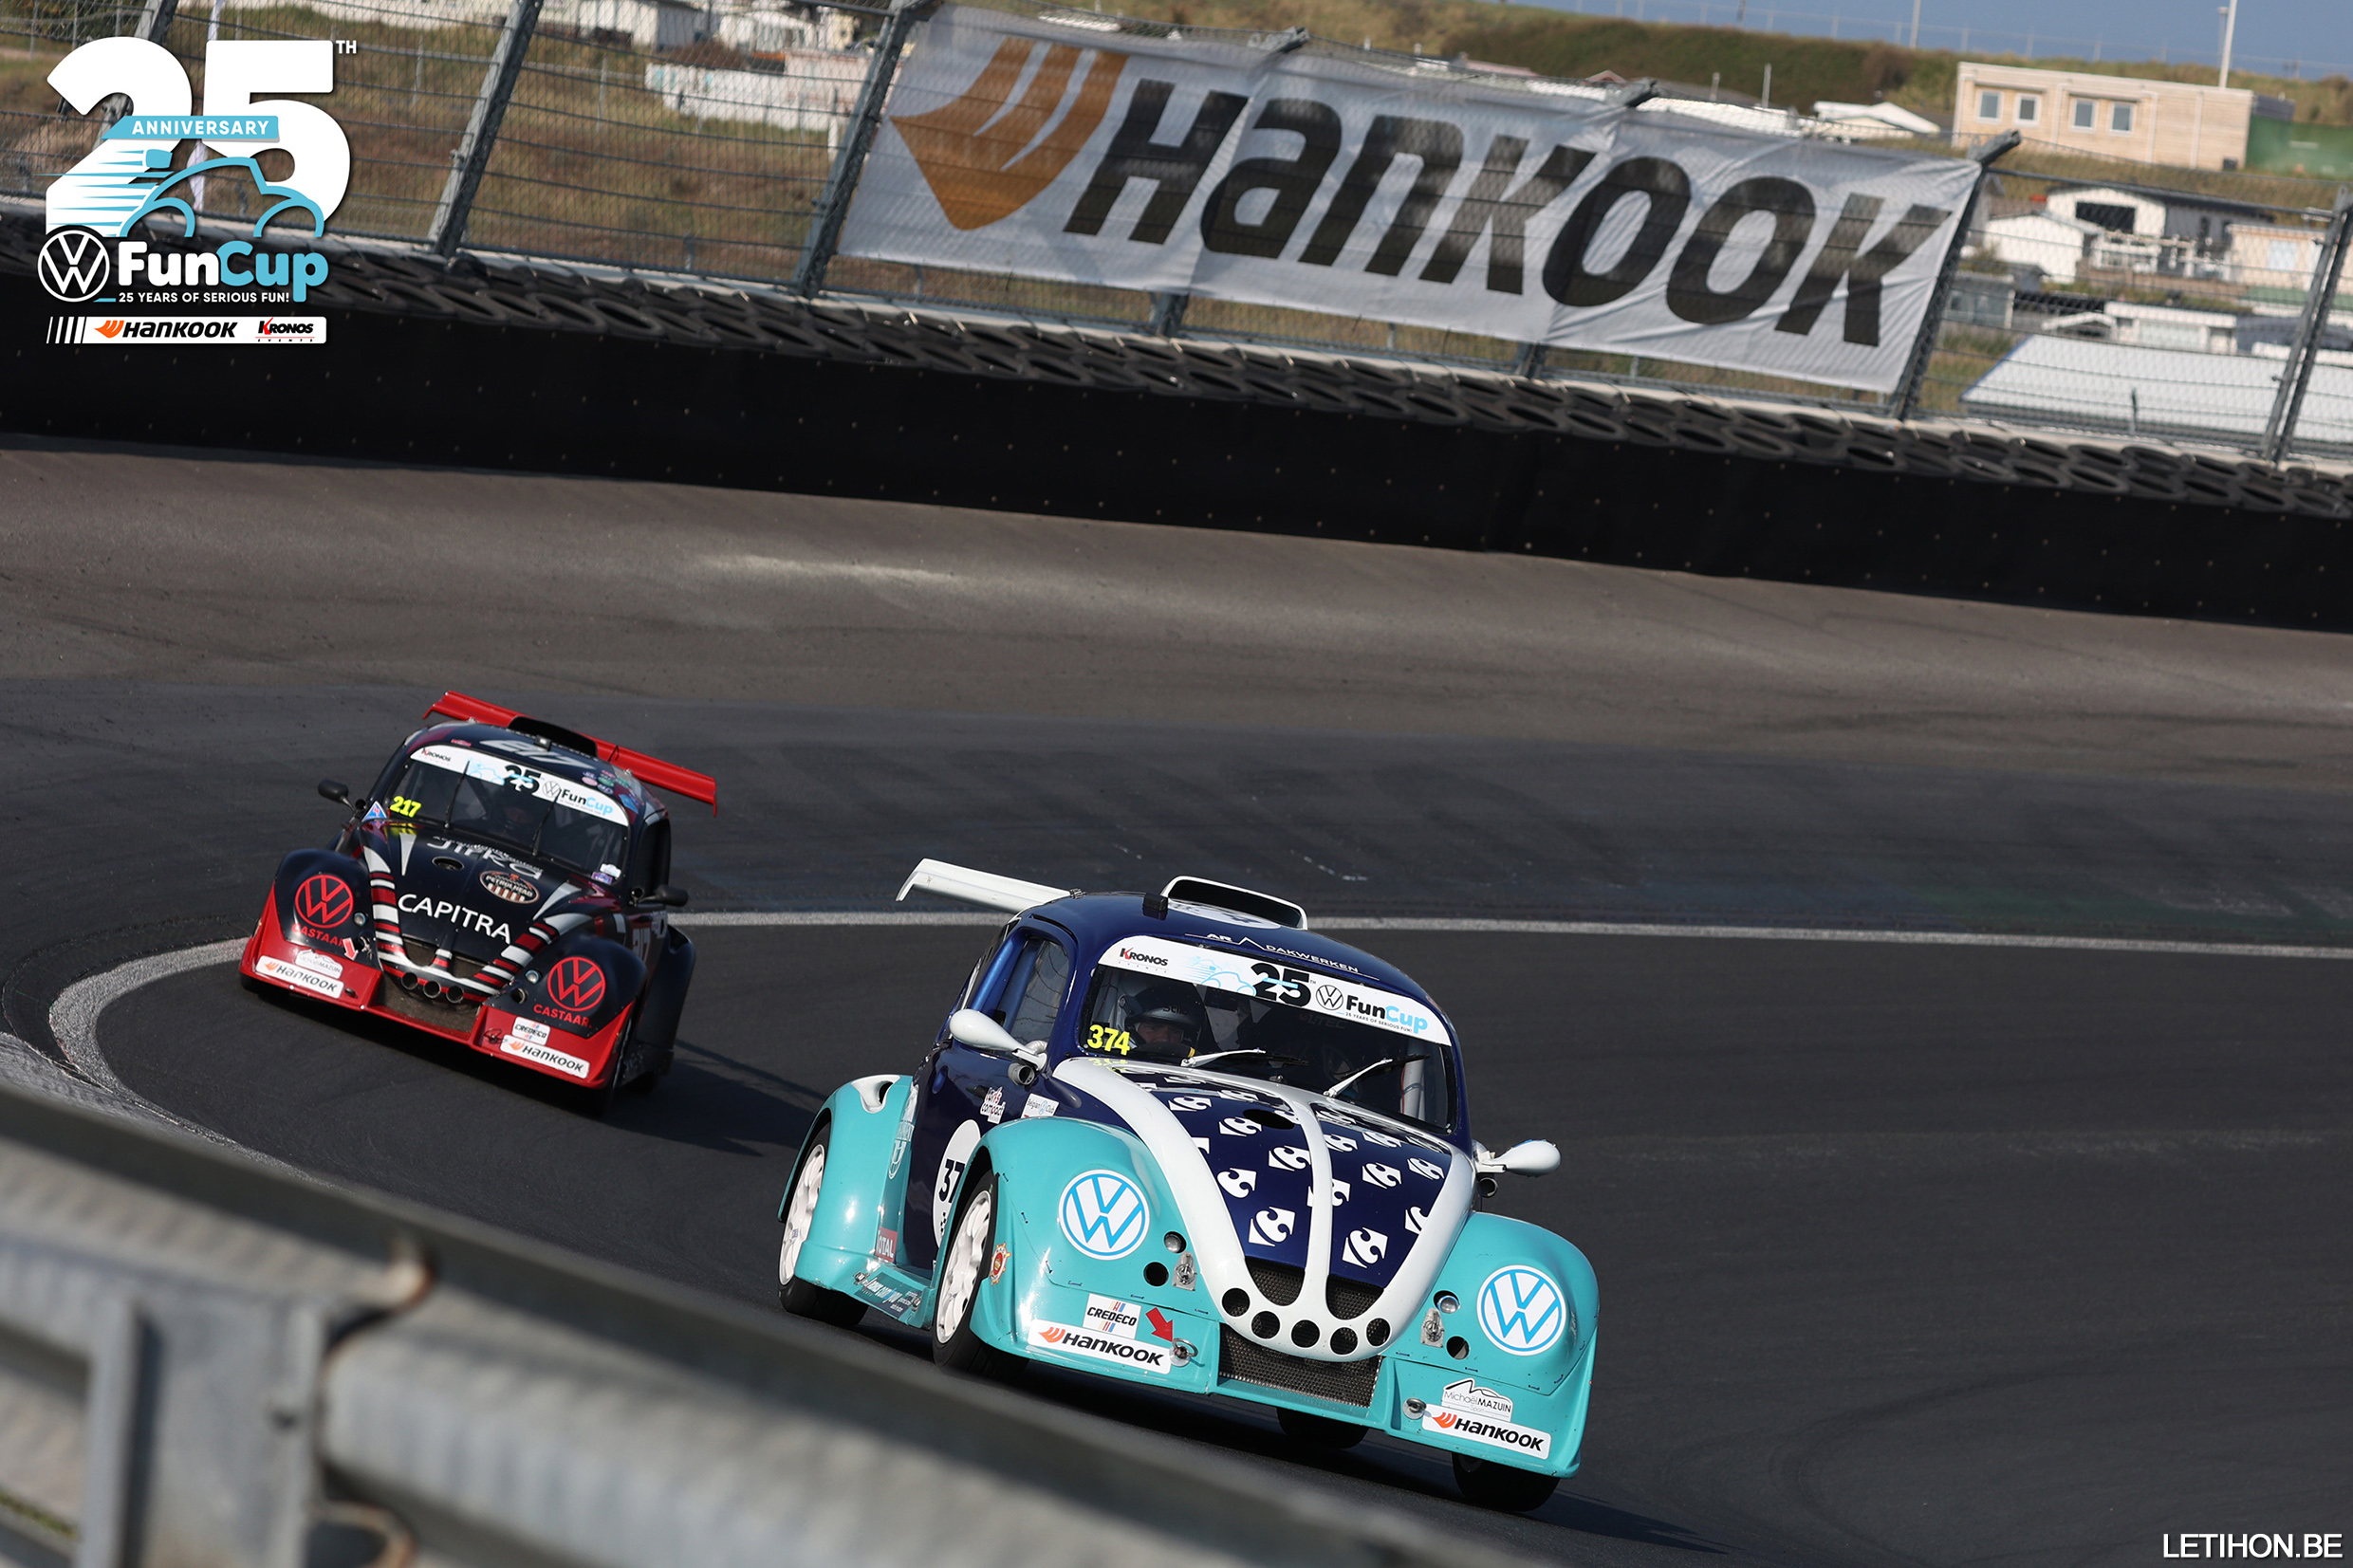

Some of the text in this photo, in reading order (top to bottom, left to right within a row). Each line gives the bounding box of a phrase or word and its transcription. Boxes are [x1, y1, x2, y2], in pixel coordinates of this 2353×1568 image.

[390, 796, 422, 818] 217
[398, 894, 511, 944] CAPITRA
[1266, 945, 1359, 973] DAKWERKEN
[1119, 947, 1169, 967] KRONOS
[1251, 963, 1311, 1006] 25
[1346, 994, 1428, 1034] FunCup
[1086, 1024, 1131, 1056] 374
[1086, 1306, 1138, 1327] CREDECO
